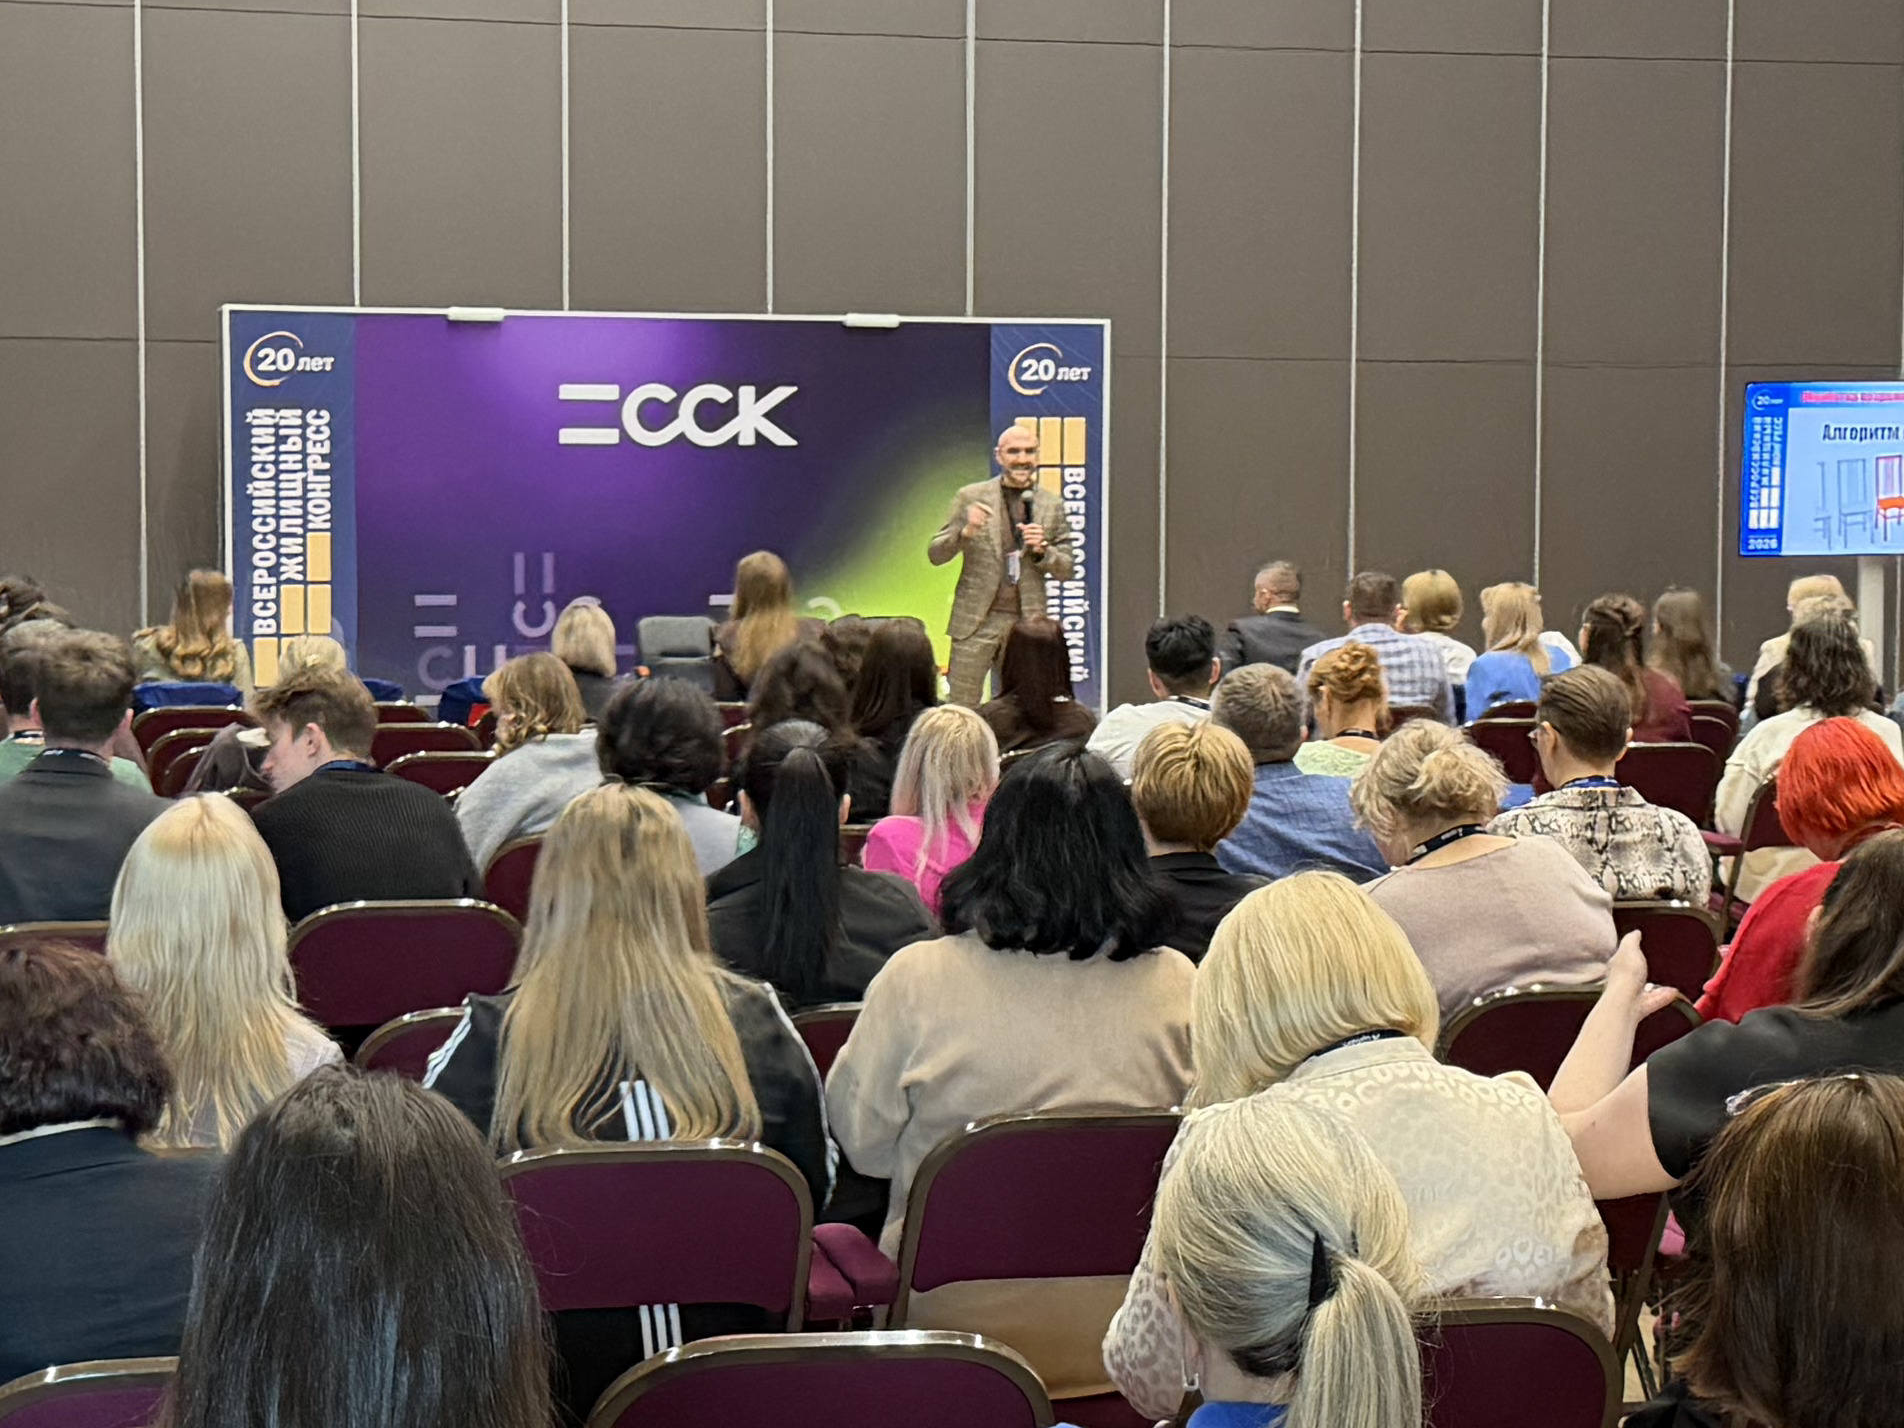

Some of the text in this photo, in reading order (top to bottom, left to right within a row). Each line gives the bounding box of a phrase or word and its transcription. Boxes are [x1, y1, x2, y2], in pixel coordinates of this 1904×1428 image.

[257, 347, 334, 372] 20 лет
[1021, 359, 1091, 381] 20 лет
[306, 409, 331, 529] КОНГРЕСС
[1822, 424, 1899, 442] Алгоритм
[245, 408, 277, 635] ВСЕРОССИЙСКИЙ
[275, 408, 308, 581] ЖИЛИЩНЫЙ
